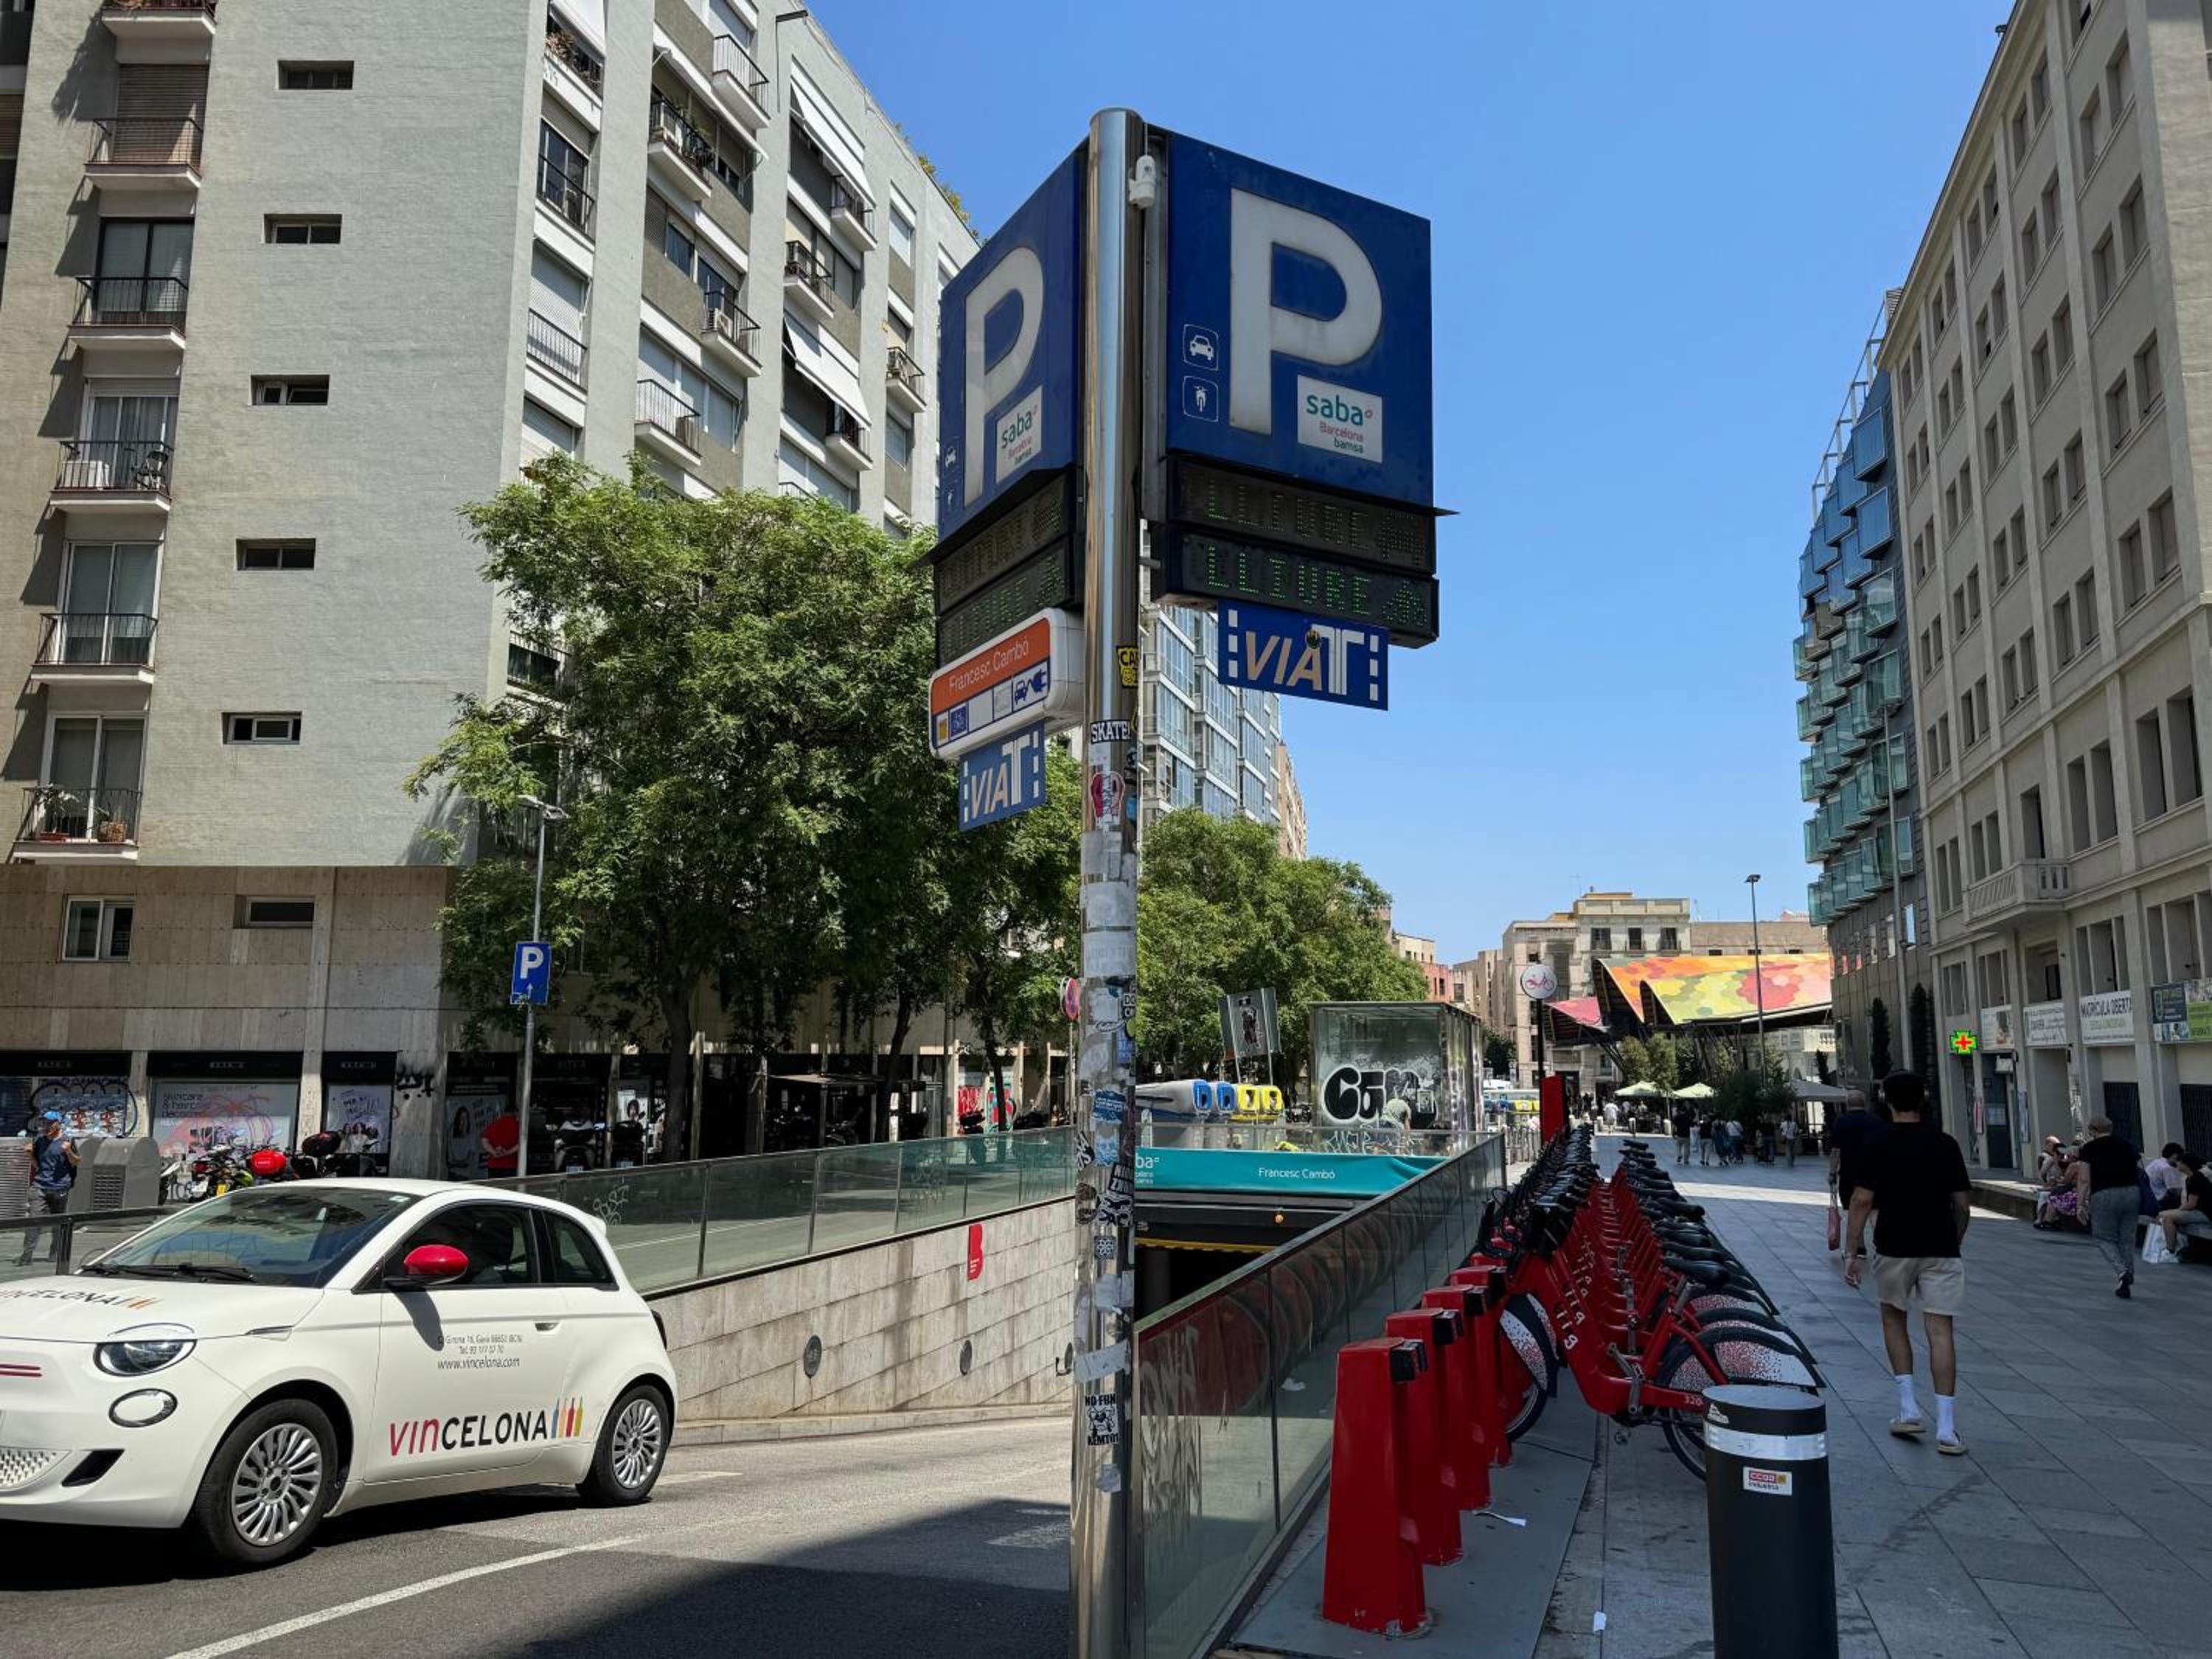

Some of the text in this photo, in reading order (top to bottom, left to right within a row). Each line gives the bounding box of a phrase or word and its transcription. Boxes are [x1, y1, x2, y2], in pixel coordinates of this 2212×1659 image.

[1231, 188, 1382, 436] P
[965, 247, 1043, 507] P
[1001, 411, 1033, 449] saba
[1306, 394, 1364, 426] saba
[1319, 420, 1363, 442] Barcelona
[1208, 542, 1371, 616] LLIURE
[949, 636, 1029, 694] Francesc Cambó
[1246, 624, 1365, 695] VIAT
[971, 734, 1031, 819] VIAT
[520, 945, 543, 980] P
[1259, 1167, 1300, 1178] Francesc
[438, 1356, 520, 1369] www.vincelona.com
